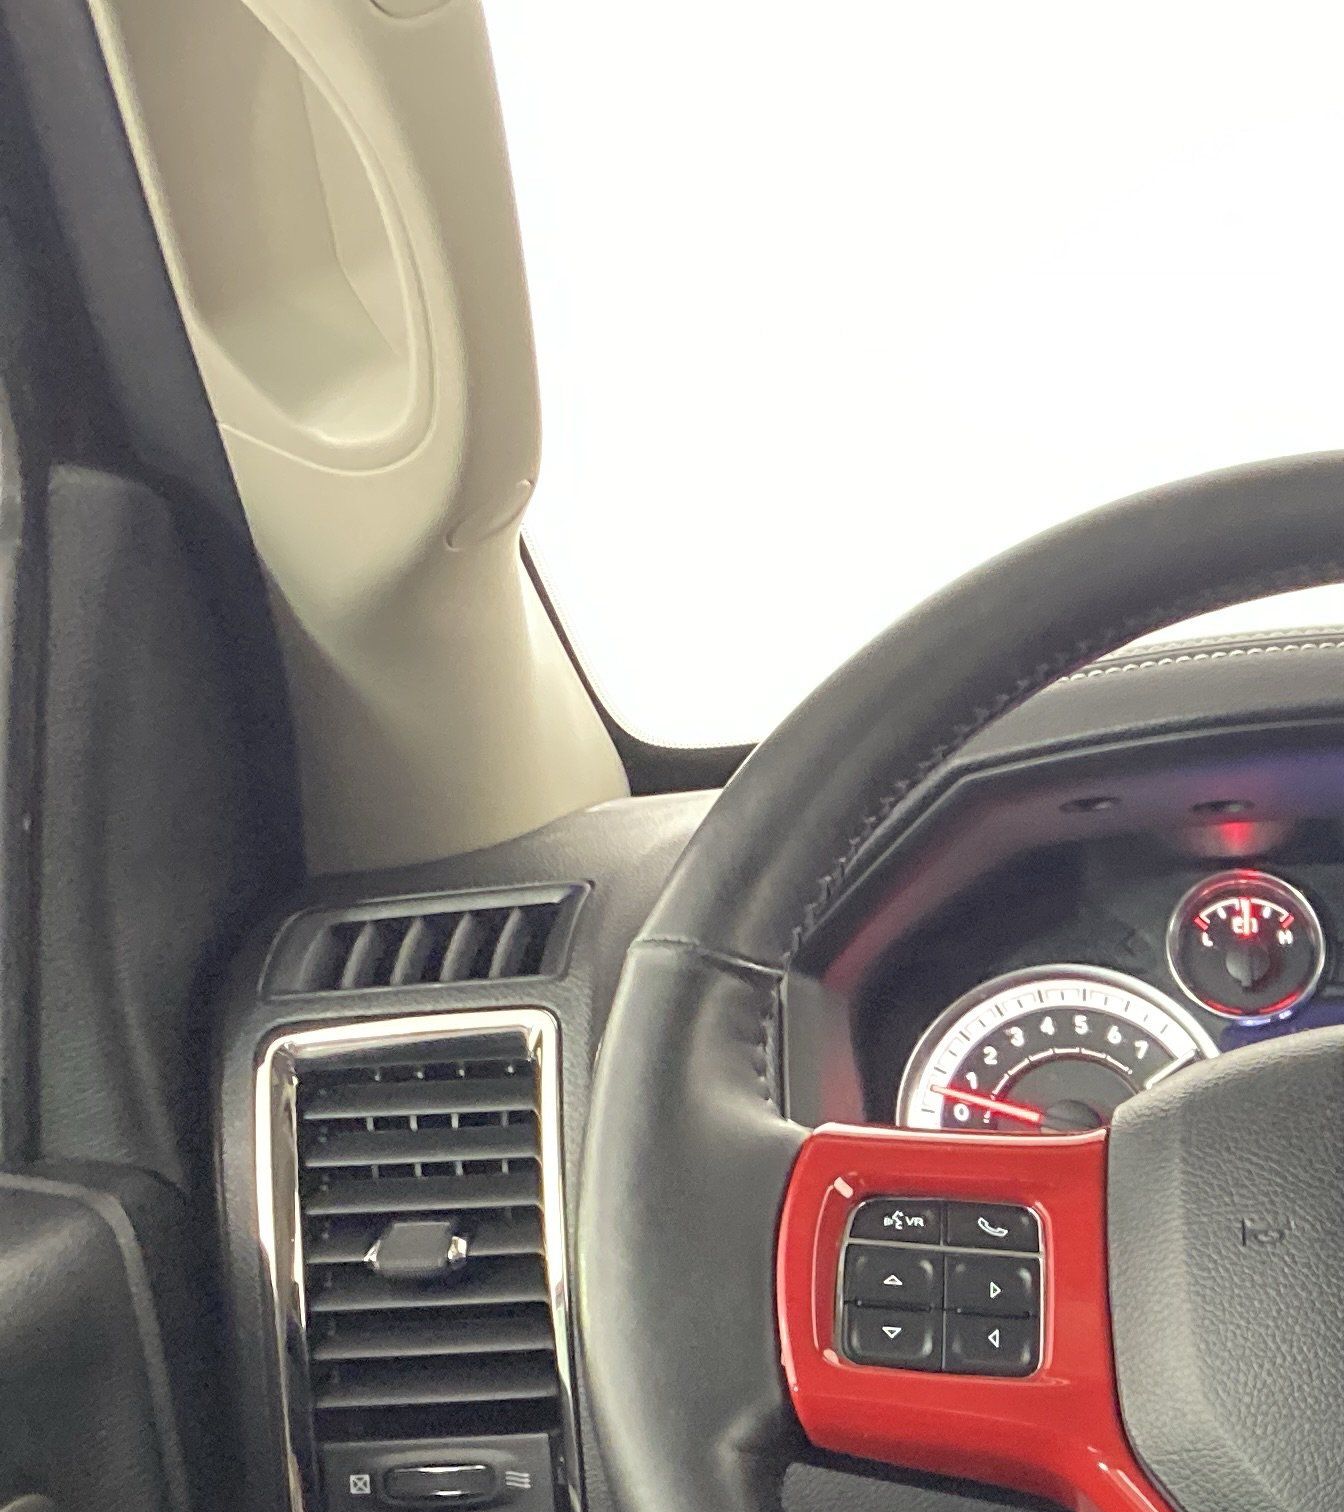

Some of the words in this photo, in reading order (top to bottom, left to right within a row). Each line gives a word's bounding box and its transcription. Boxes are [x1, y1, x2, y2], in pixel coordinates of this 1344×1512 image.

[1040, 1015, 1056, 1036] 4
[1073, 1014, 1090, 1036] 5
[1106, 1024, 1122, 1045] 6
[1006, 1025, 1026, 1048] 3
[982, 1044, 998, 1066] 2
[1134, 1039, 1150, 1060] 7
[965, 1071, 978, 1090] 1
[953, 1102, 970, 1122] 0
[904, 1215, 925, 1228] VR
